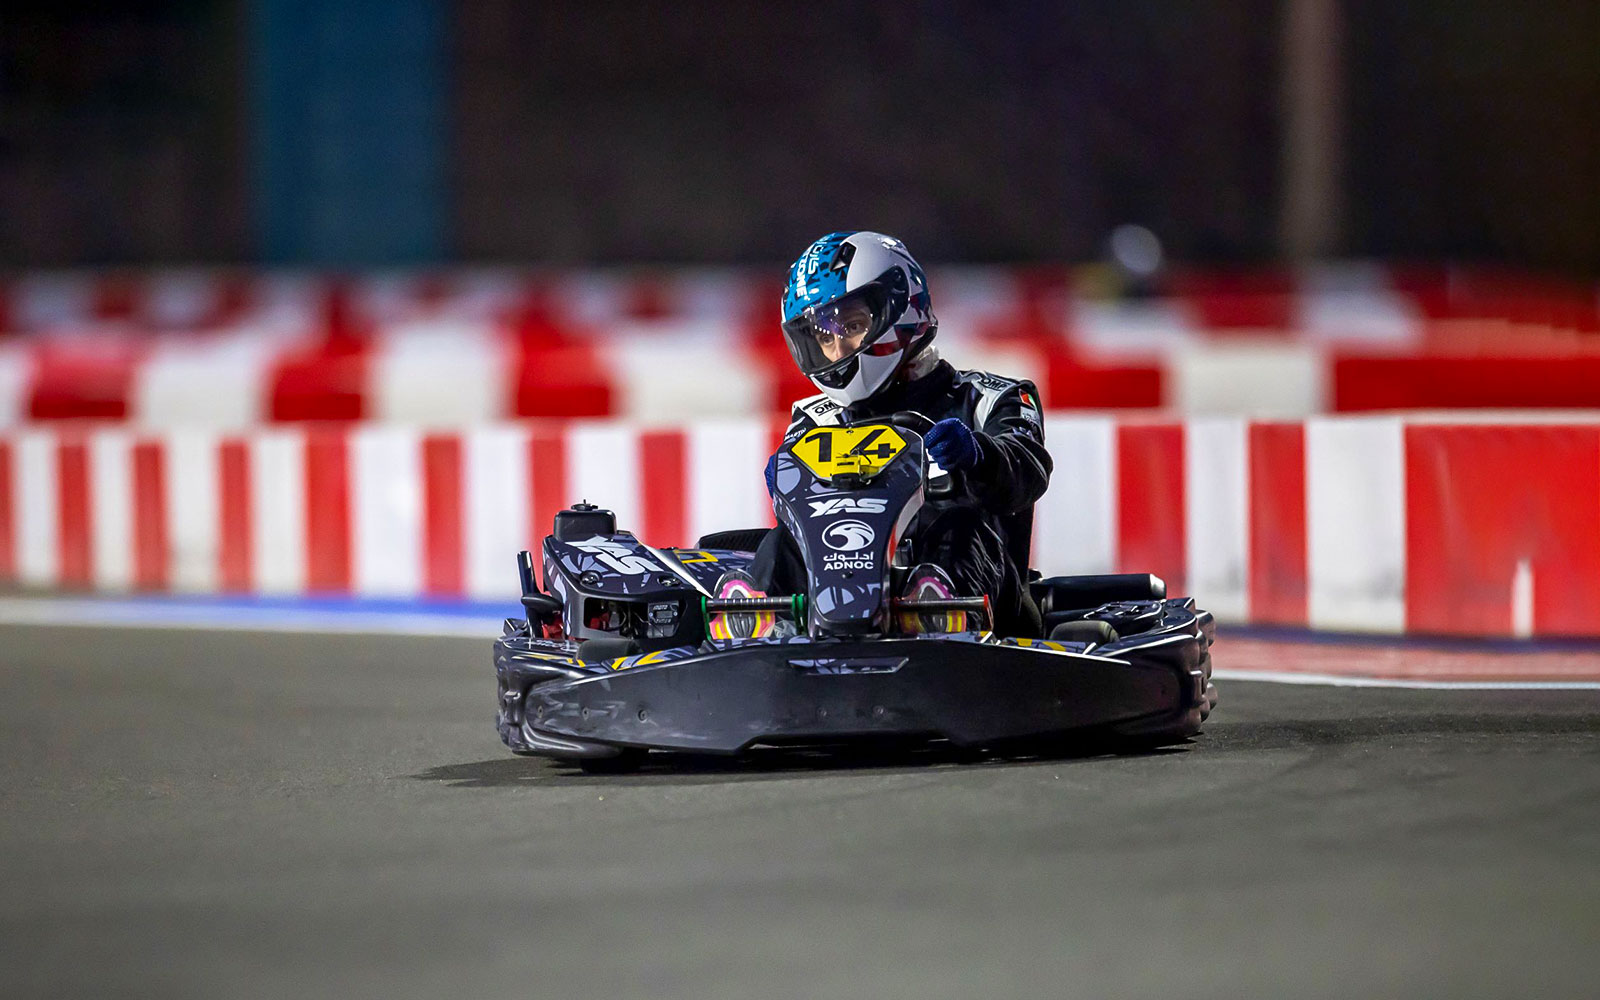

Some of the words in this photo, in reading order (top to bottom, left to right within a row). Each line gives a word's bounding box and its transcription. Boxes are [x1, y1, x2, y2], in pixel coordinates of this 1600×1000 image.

[981, 377, 1008, 389] OMP
[805, 428, 897, 463] 14
[808, 498, 888, 517] YAS
[565, 536, 664, 575] YAS
[823, 561, 874, 571] ADNOC
